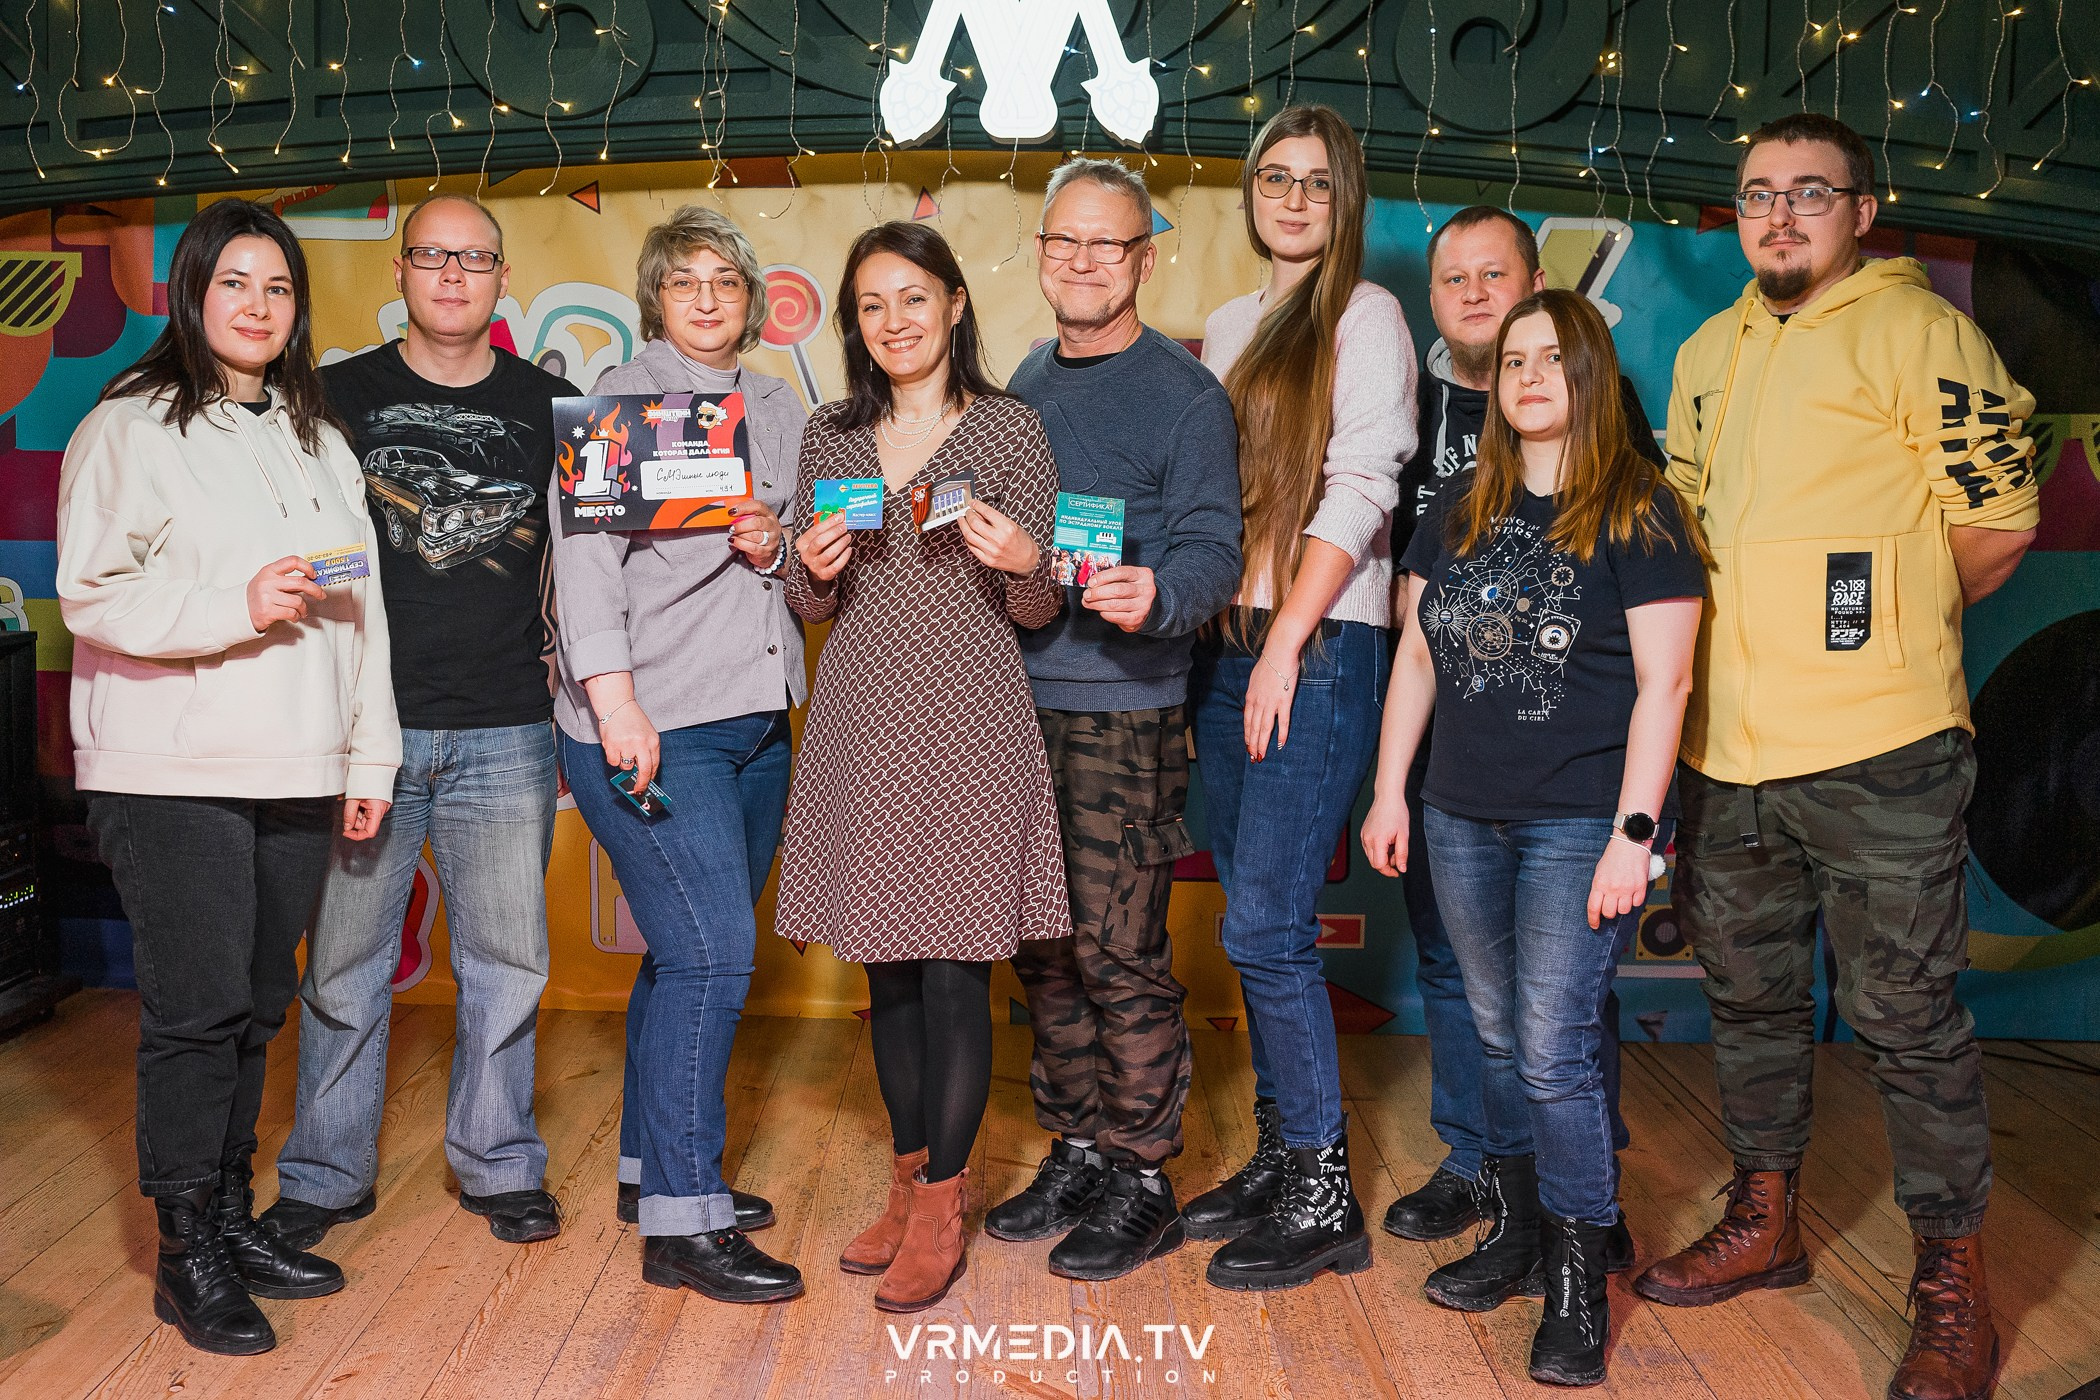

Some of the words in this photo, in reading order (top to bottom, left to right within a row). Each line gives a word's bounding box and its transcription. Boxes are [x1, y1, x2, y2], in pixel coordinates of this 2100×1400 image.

[652, 448, 688, 457] КОТОРАЯ
[688, 448, 711, 456] ДАЛА
[574, 504, 626, 518] МЕСТО
[1069, 500, 1114, 510] СЕРТИФИКАТ
[1068, 520, 1102, 528] ЭСТРАДНОМУ
[1494, 526, 1532, 539] STARS
[1316, 1146, 1334, 1161] LOVE
[1298, 1218, 1316, 1229] LOVE
[1562, 1277, 1570, 1309] NORTHLAND
